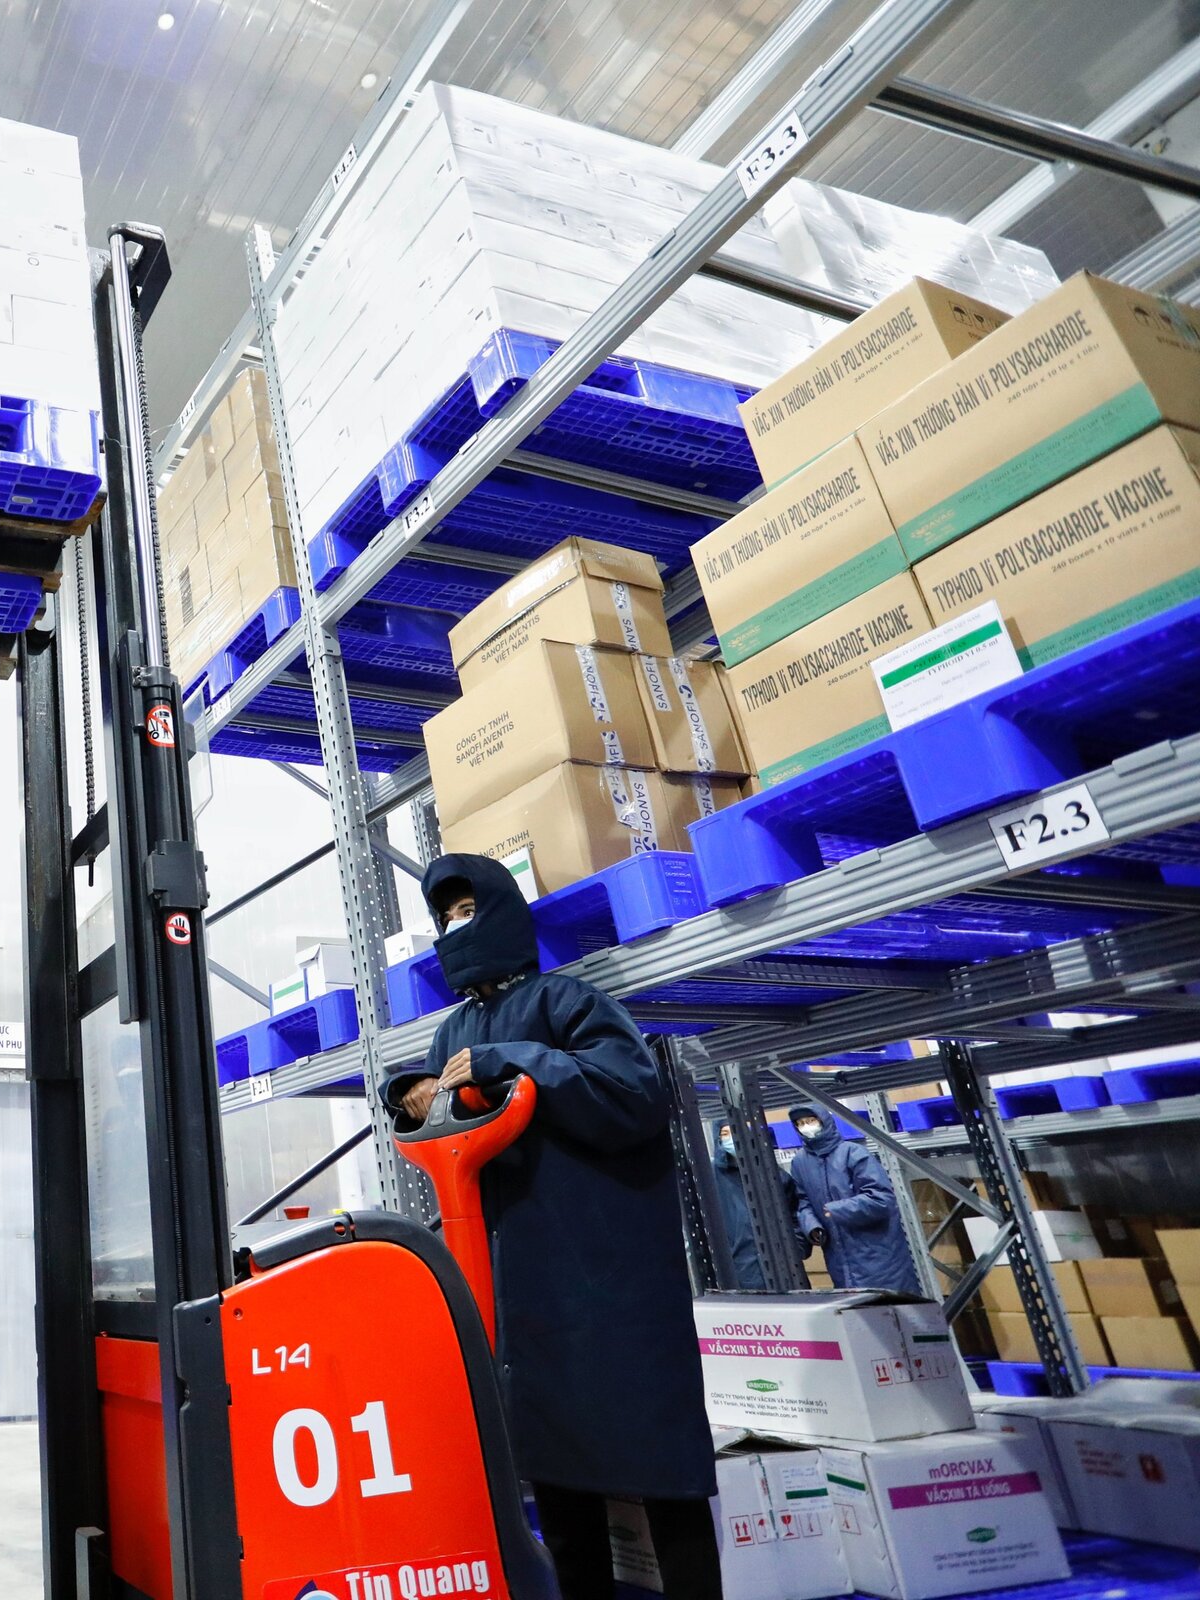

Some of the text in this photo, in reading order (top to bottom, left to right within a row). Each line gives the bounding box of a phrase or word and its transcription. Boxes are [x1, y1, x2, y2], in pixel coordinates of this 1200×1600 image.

[747, 126, 797, 180] F3.3
[752, 407, 770, 437] VẮC
[770, 402, 784, 427] XIN
[813, 366, 834, 394] HÀN
[841, 306, 917, 374] POLYSACCHARIDE
[854, 372, 865, 383] 240
[876, 430, 899, 466] VẮC
[895, 425, 917, 455] XIN
[952, 382, 980, 418] HÀN
[989, 310, 1092, 392] POLYSACCHARIDE
[405, 497, 431, 529] F3.2
[704, 552, 721, 584] VẮC
[718, 550, 734, 575] XIN
[761, 518, 781, 546] HÀN
[787, 467, 860, 530] POLYSACCHARIDE
[800, 531, 810, 541] 240
[932, 564, 983, 613] TYPHOID
[997, 500, 1109, 580] POLYSACCHARIDE
[1103, 466, 1173, 522] VACCINE
[1051, 560, 1066, 574] 240
[1068, 546, 1095, 564] boxes
[1117, 524, 1139, 542] vials
[1157, 504, 1181, 522] dose
[481, 614, 541, 663] SANOFI AVENTIS
[494, 634, 529, 664] VIỆT NAM
[741, 675, 778, 712] TYPHOID
[787, 628, 869, 686] POLYSACCHARIDE
[864, 604, 912, 647] VACCINE
[645, 662, 668, 709] SANOFI
[827, 676, 838, 686] 240
[839, 667, 858, 680] boxes
[928, 656, 964, 676] TYPHOID
[456, 711, 510, 752] CÔNG TY TNHH
[456, 721, 514, 764] SANOFI AVENTIS
[686, 702, 708, 750] SANOFI
[468, 740, 504, 768] VIỆT NAM
[634, 782, 652, 834] SANOFI
[1000, 800, 1090, 853] F2.3
[496, 841, 505, 853] TY
[506, 830, 530, 847] TNHH
[708, 1340, 749, 1355] VẮCXIN
[767, 1342, 800, 1357] UỐNG
[712, 1324, 785, 1337] mORCVAX
[273, 1401, 412, 1507] 01
[928, 1458, 995, 1479] mORCVAX
[345, 1560, 490, 1600] Tín Quang
